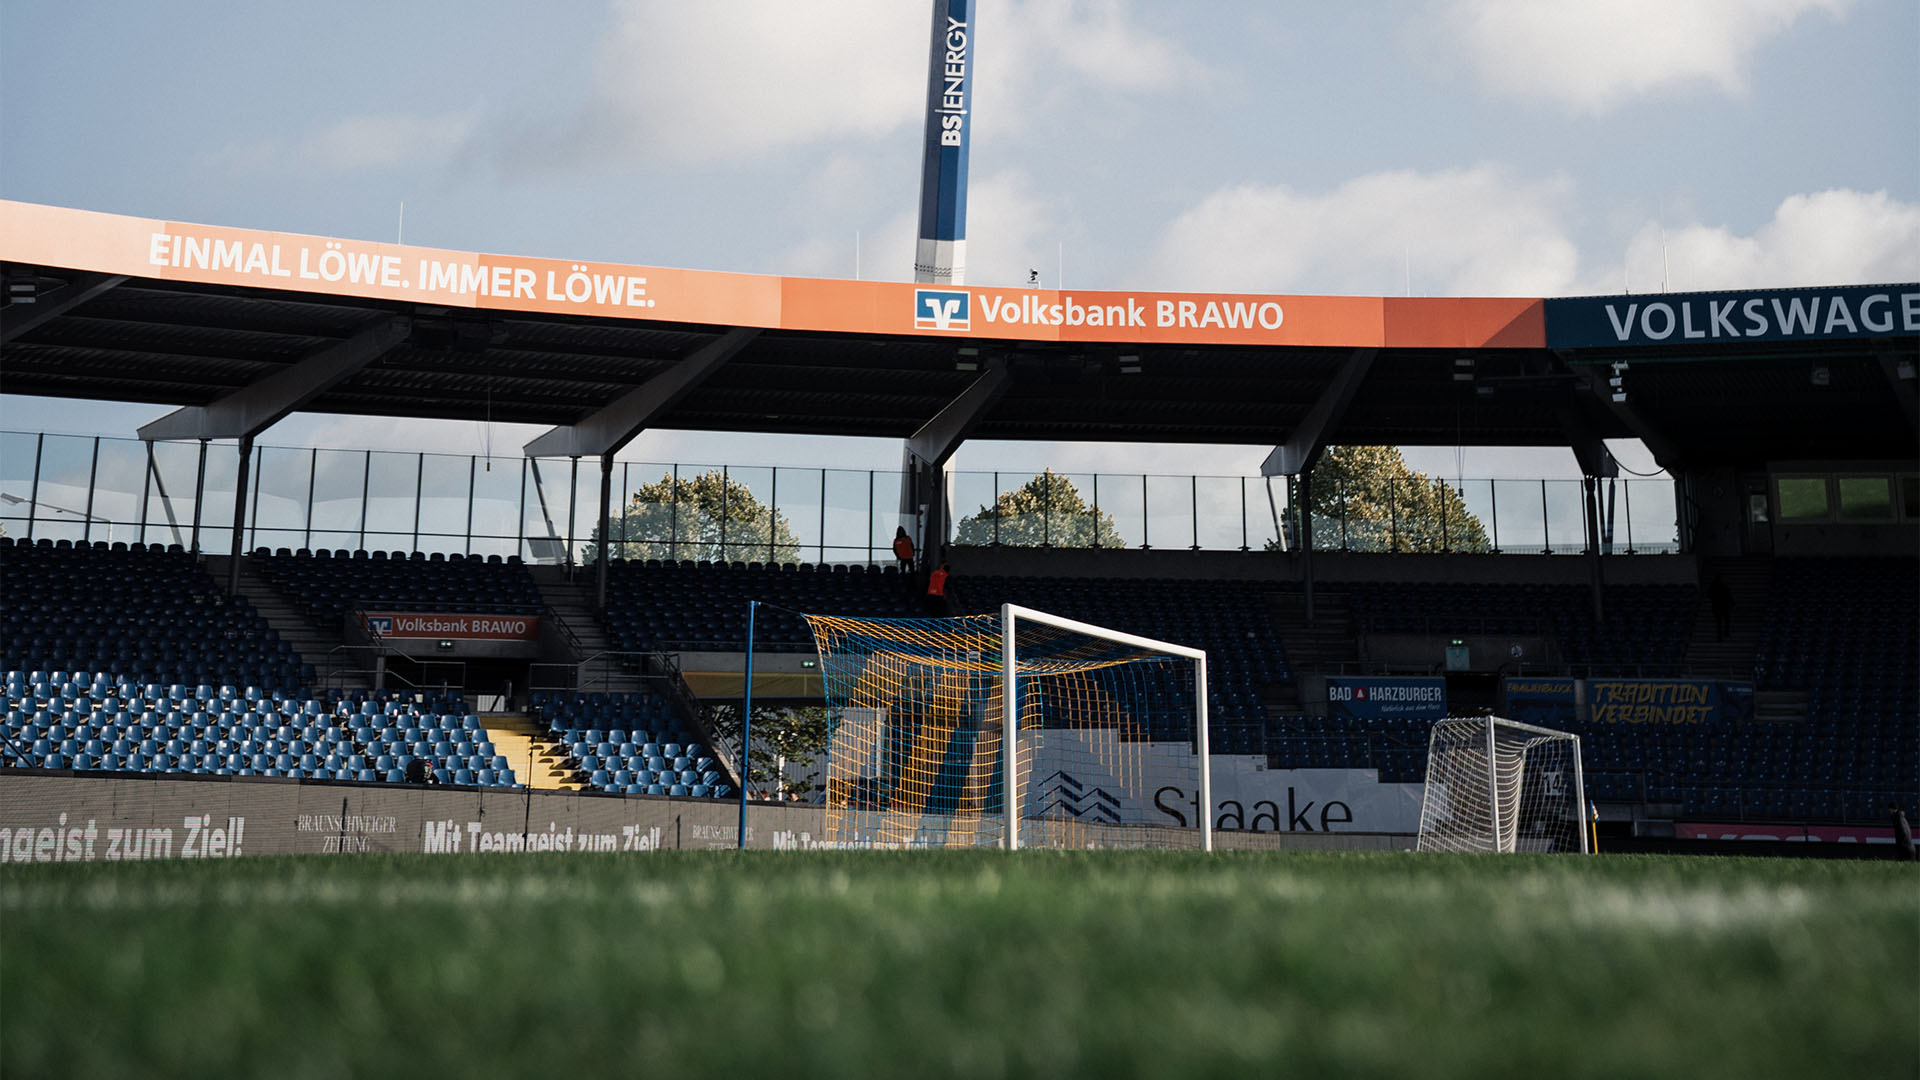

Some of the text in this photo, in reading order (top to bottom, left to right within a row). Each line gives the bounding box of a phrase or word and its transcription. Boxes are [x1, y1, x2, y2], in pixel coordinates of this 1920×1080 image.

[149, 233, 656, 308] EINMAL LÖWE. IMMER LÖWE.
[979, 294, 1284, 330] Volksbank BRAWO
[1604, 292, 1920, 342] VOLKSWAGE
[396, 618, 526, 634] Volksbank BRAWO
[1329, 686, 1441, 701] BAD HARZBURGER
[1593, 683, 1709, 704] TRADITION
[1591, 704, 1714, 725] VERBINDET
[1543, 774, 1562, 793] 14
[297, 814, 397, 833] BRAUNSCHWEIGER
[105, 828, 173, 861] zum
[181, 814, 246, 859] Ziel!
[322, 836, 371, 853] ZEITUNG
[424, 819, 462, 853] Mit
